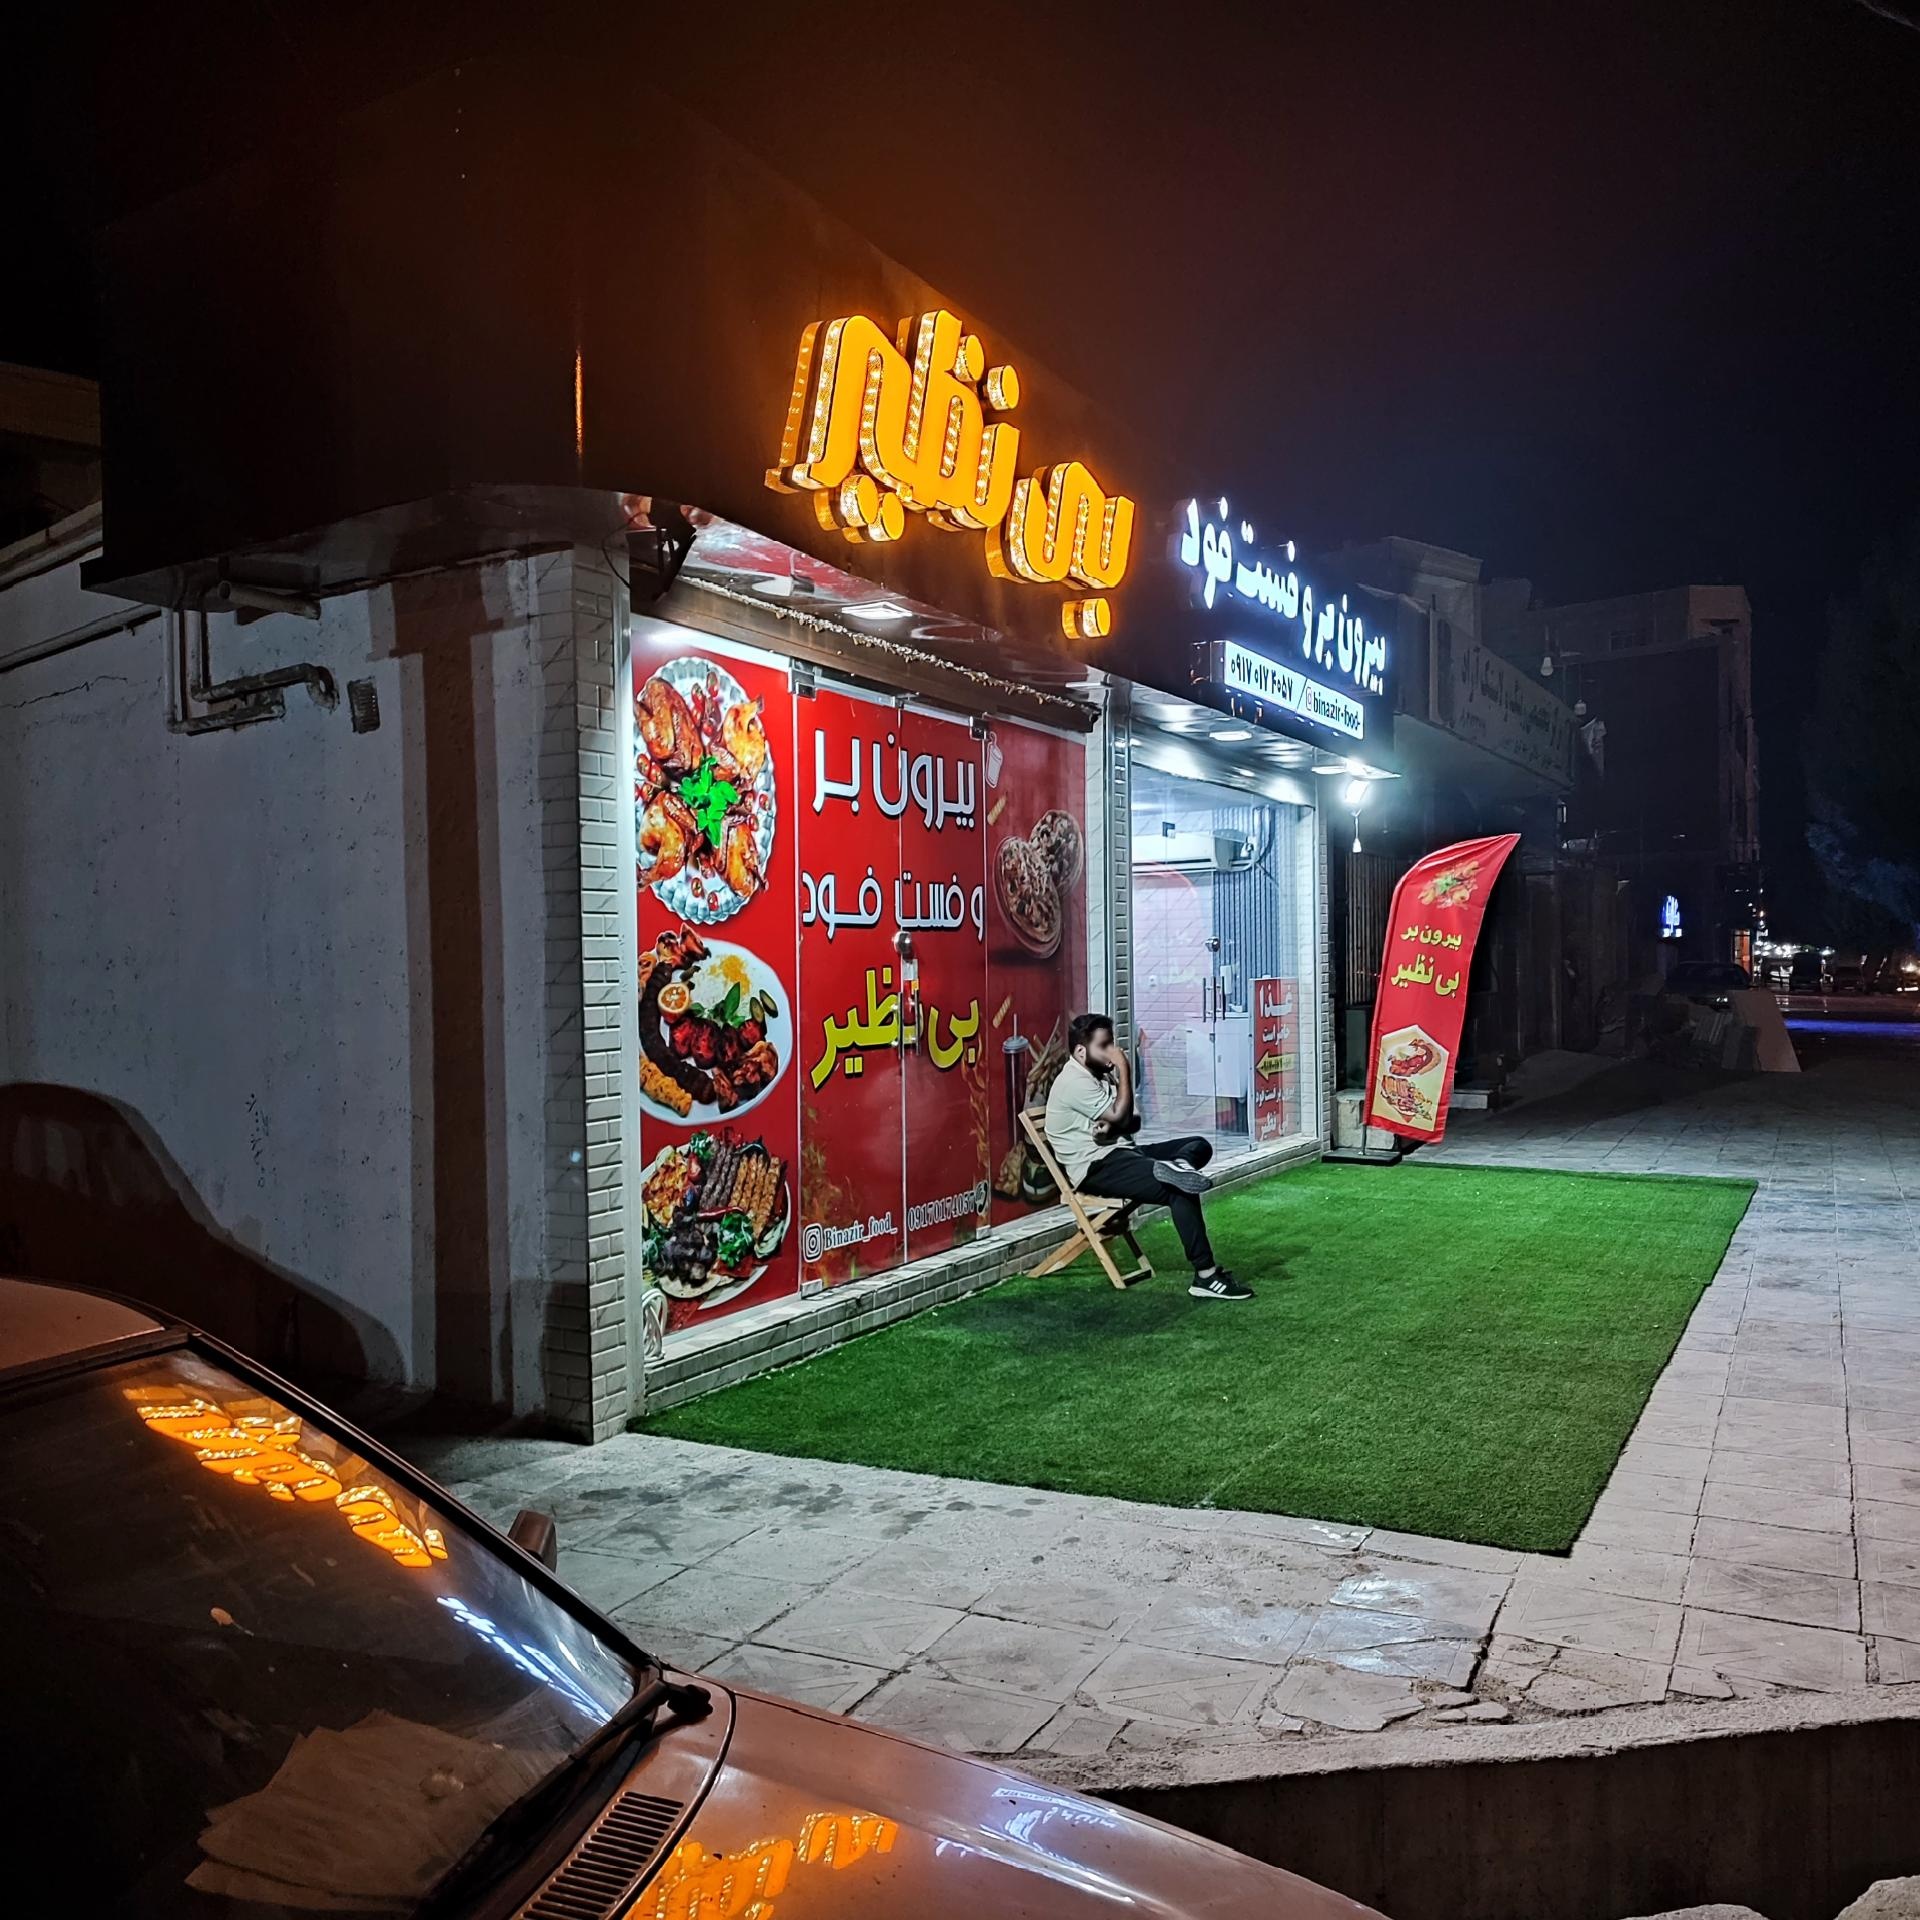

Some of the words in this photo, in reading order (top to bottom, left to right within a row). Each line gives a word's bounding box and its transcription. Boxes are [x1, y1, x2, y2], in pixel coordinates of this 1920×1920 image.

[778, 308, 1021, 543] نظیر
[1006, 461, 1136, 638] بی
[1181, 496, 1233, 610] فود
[1235, 519, 1299, 620] فست
[1338, 593, 1386, 696] بیرون
[811, 729, 861, 813] بر
[872, 733, 976, 830] بیرون
[802, 866, 882, 940] فود
[894, 872, 965, 928] فست
[970, 885, 983, 941] و
[1400, 925, 1419, 942] بر
[1390, 953, 1434, 988] نظیر
[1420, 925, 1462, 951] بیرون
[1435, 971, 1460, 998] بی
[927, 999, 979, 1069] بی
